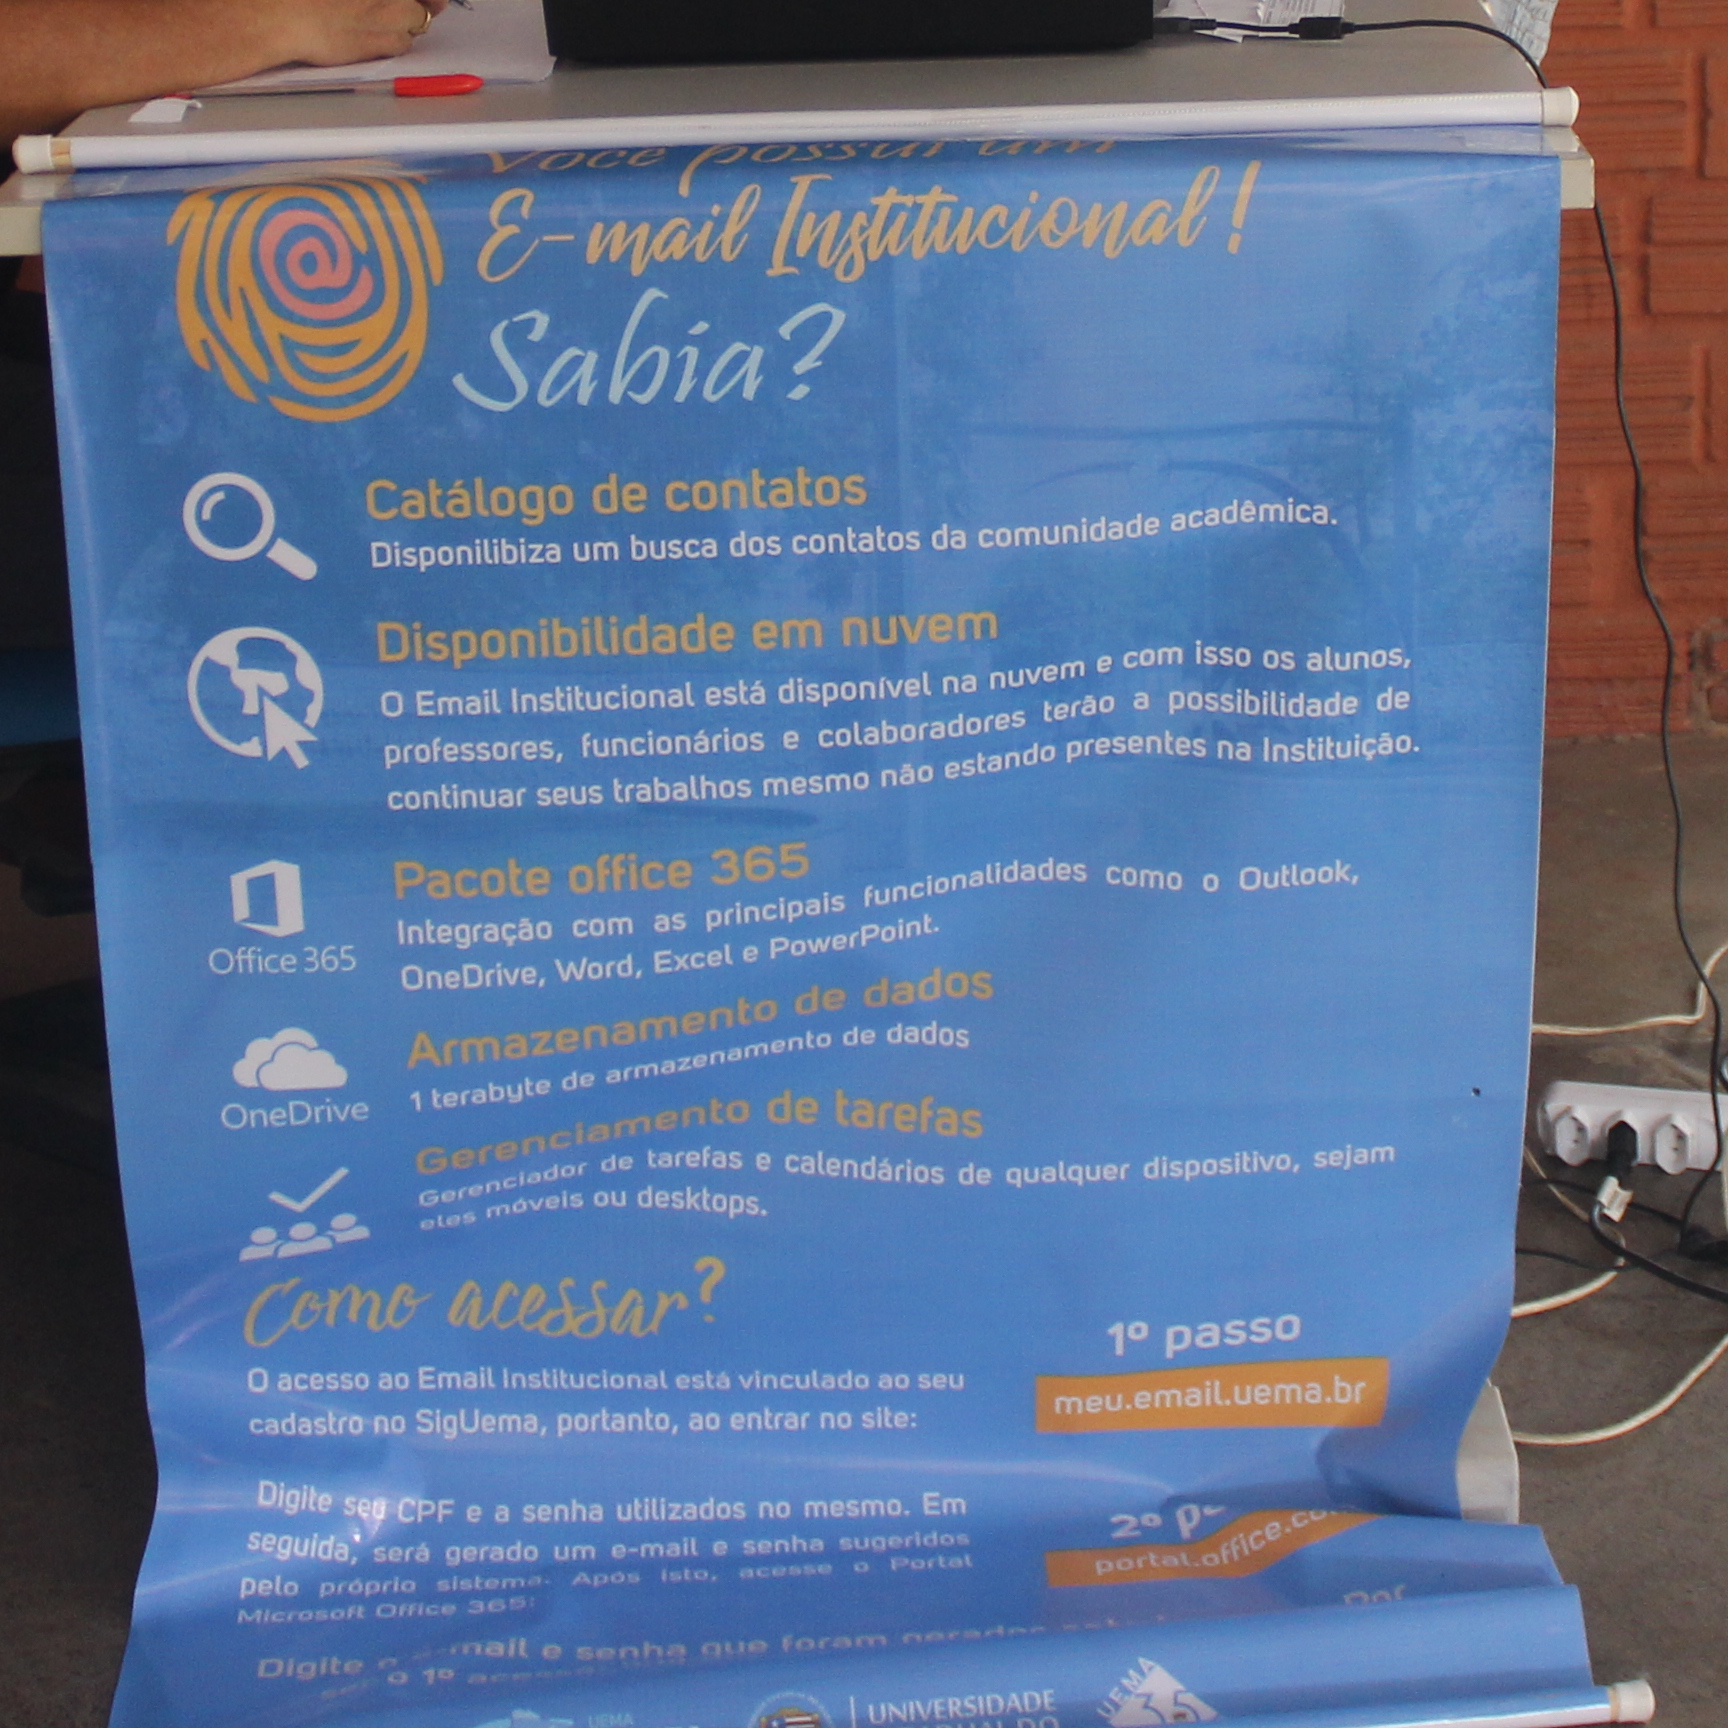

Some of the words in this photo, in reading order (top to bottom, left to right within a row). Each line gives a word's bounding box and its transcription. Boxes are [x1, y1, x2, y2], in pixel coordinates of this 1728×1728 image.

[476, 187, 758, 283] E-mail
[454, 289, 845, 414] Sabia?
[365, 476, 575, 527] Catálogo
[591, 472, 649, 516] de
[664, 466, 868, 513] contatos
[376, 612, 736, 670] Disponibilidade
[751, 617, 825, 651] em
[840, 610, 999, 648] nuvem
[393, 857, 552, 900] Pacote
[568, 852, 694, 895] office
[710, 841, 810, 886] 365
[406, 997, 778, 1070] Armazenamento
[794, 985, 847, 1016] de
[863, 966, 994, 1008] dados
[415, 1097, 751, 1175] Gerenciamento
[766, 1089, 820, 1125] de
[835, 1089, 984, 1139] tarefas
[418, 1162, 588, 1208] Gerenciador
[600, 1154, 634, 1174] de
[647, 1145, 744, 1171] tarefas
[755, 1152, 772, 1173] e
[784, 1150, 946, 1186] calendários
[957, 1162, 993, 1187] de
[1005, 1160, 1131, 1189] qualquer
[1143, 1151, 1300, 1182] dispositivo,
[1313, 1144, 1396, 1171] sejam
[243, 1274, 425, 1349] Como
[447, 1256, 726, 1344] acessar?
[246, 1367, 270, 1396] O
[276, 1372, 371, 1394] acesso
[377, 1372, 410, 1392] ao
[417, 1366, 496, 1391] Email
[502, 1367, 669, 1391] Institucional
[674, 1370, 732, 1391] está
[738, 1369, 871, 1392] vinculado
[877, 1373, 911, 1391] ao
[917, 1373, 965, 1391] seu
[1054, 1375, 1367, 1415] meu.email.uema.br
[249, 1409, 369, 1437] cadastro
[373, 1413, 408, 1436] no
[415, 1408, 547, 1442] SigUema,
[557, 1407, 679, 1438] portanto,
[688, 1412, 721, 1432] ao
[730, 1407, 810, 1432] entrar
[820, 1412, 853, 1430] no
[861, 1406, 917, 1430] site:
[256, 1480, 334, 1516] Digite
[343, 1497, 385, 1520] seu
[397, 1498, 455, 1524] CPF
[466, 1505, 482, 1523] e
[494, 1505, 510, 1523] a
[522, 1499, 603, 1523] senha
[616, 1497, 746, 1523] utilizados
[758, 1501, 791, 1519] no
[804, 1499, 910, 1519] mesmo.
[922, 1491, 968, 1517] Em
[372, 1542, 431, 1564] será
[444, 1540, 539, 1568] gerado
[553, 1545, 597, 1562] um
[610, 1537, 699, 1560] e-mail
[712, 1540, 729, 1557] e
[742, 1535, 825, 1557] senha
[839, 1531, 970, 1553] sugeridos
[237, 1605, 365, 1624] Microsoft
[375, 1603, 457, 1619] Office
[467, 1595, 536, 1616] 365:
[867, 1690, 1057, 1725] UNIVERSIDADE
